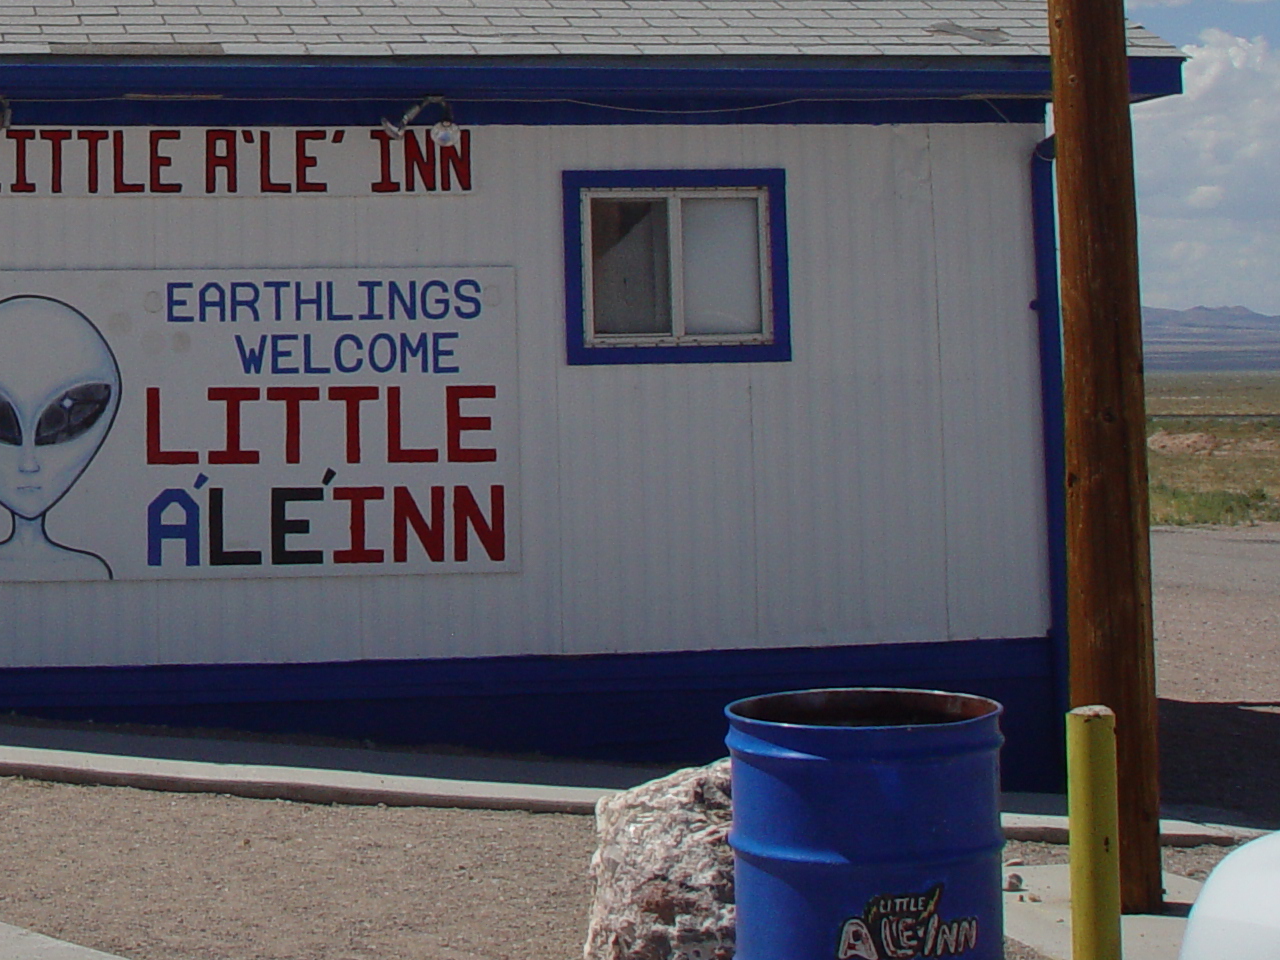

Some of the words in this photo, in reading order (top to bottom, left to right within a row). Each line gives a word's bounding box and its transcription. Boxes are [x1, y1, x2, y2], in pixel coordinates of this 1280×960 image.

[370, 129, 472, 192] INN
[167, 279, 483, 323] EARTHLINGS
[235, 332, 462, 375] WELCOME
[146, 385, 497, 465] LITTLE
[878, 896, 926, 914] LITTLE
